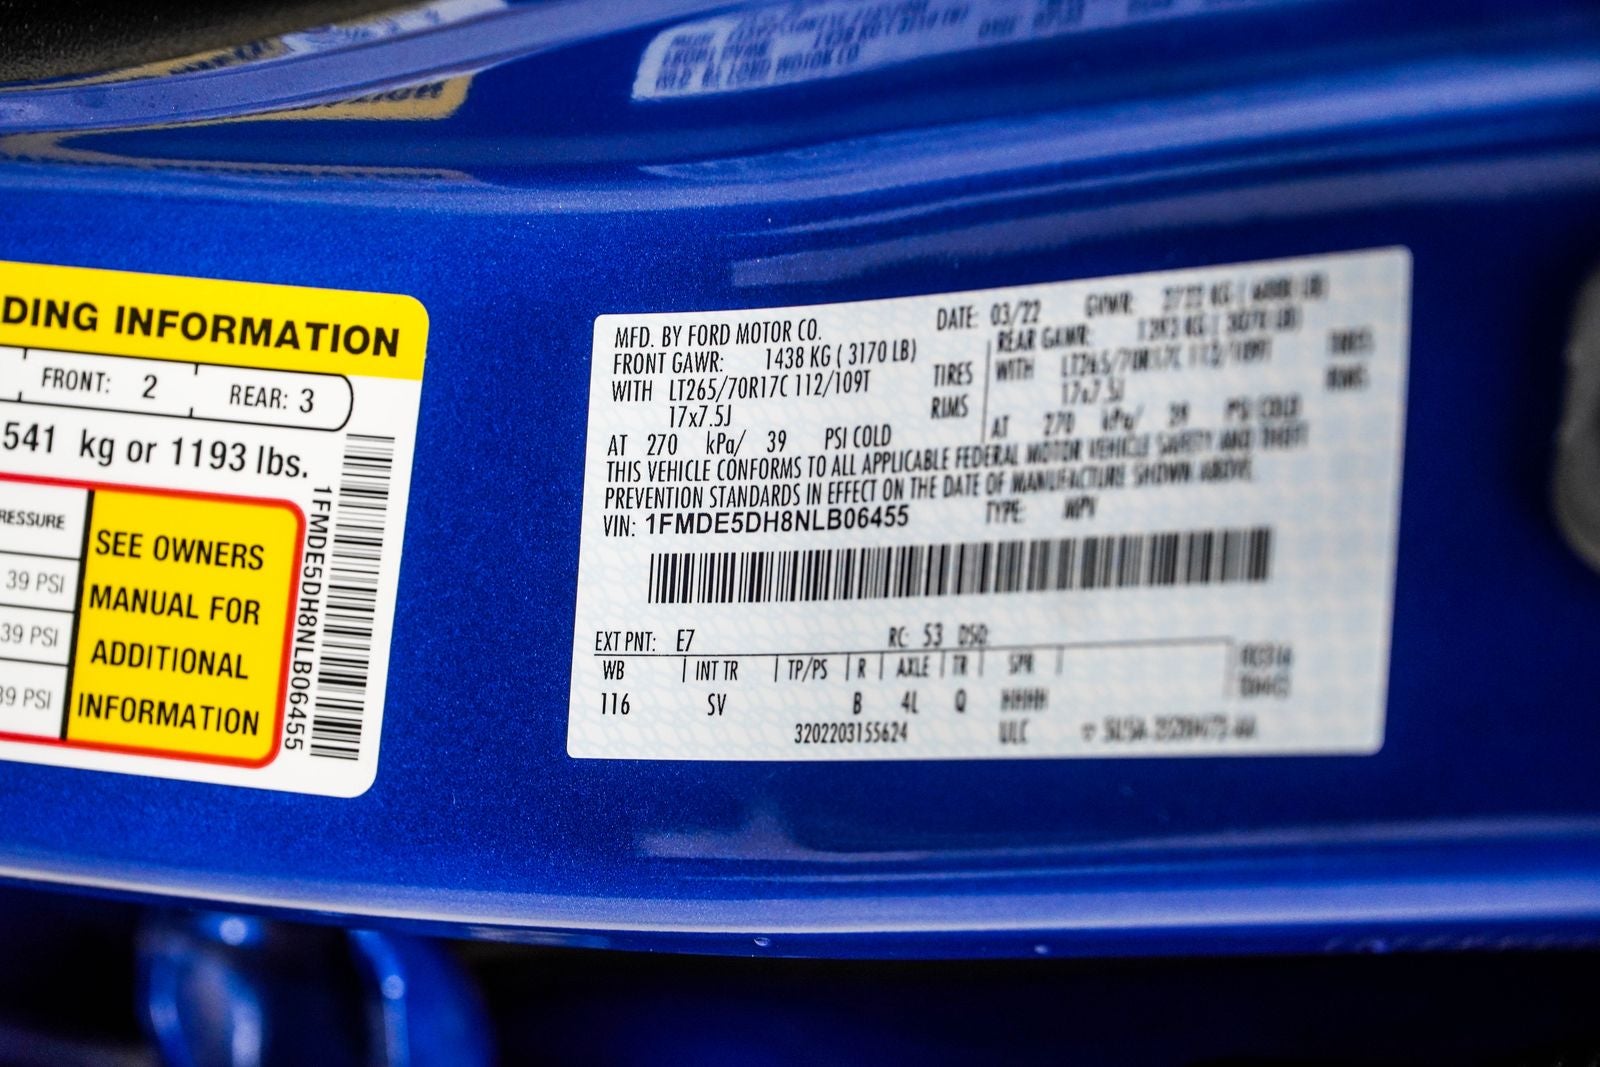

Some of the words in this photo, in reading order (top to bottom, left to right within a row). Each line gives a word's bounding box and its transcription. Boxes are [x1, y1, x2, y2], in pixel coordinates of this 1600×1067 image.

[0, 296, 98, 331] DING
[114, 306, 399, 358] INFORMATION
[937, 305, 979, 331] DATE:
[990, 298, 1041, 327] 03/22
[614, 326, 654, 348] MFD.
[662, 325, 682, 346] BY
[688, 323, 730, 346] FORD
[736, 320, 791, 345] MOTOR
[798, 319, 822, 342] CO.
[613, 352, 665, 374] FRONT
[672, 350, 724, 374] GAWR:
[766, 346, 804, 370] 1438
[810, 344, 831, 368] KG
[848, 341, 887, 366] 3170
[892, 339, 917, 363] LB)
[42, 367, 111, 393] FRONT:
[142, 375, 158, 399] 2
[612, 380, 652, 402] WITH
[669, 375, 789, 401] LT265/70R17C
[795, 369, 870, 397] 112/109T
[933, 361, 973, 387] TIRES
[229, 384, 287, 410] REAR:
[299, 389, 314, 413] 3
[931, 395, 968, 420] RIMS
[669, 405, 732, 428] 17x7.5J
[991, 414, 1010, 438] AT
[3, 422, 54, 453] 541
[80, 429, 114, 467] kg
[127, 440, 157, 463] or
[171, 438, 246, 472] 1193
[257, 445, 308, 479] lbs.
[607, 434, 627, 456] AT
[647, 433, 678, 456] 270
[706, 429, 746, 456] kPa/
[767, 431, 786, 452] 39
[825, 427, 849, 450] PSI
[854, 424, 892, 448] COLD
[607, 460, 641, 482] THIS
[648, 458, 711, 482] VEHICLE
[717, 457, 801, 481] CONFORMS
[808, 455, 826, 478] TO
[831, 453, 859, 477] ALL
[862, 449, 948, 476] APPLICABLE
[955, 439, 1018, 468] FEDERAL
[1026, 437, 1081, 464] MOTOR
[605, 486, 703, 510] PREVENTION
[709, 483, 800, 508] STANDARDS
[806, 482, 822, 507] IN
[828, 480, 877, 505] EFFECT
[882, 478, 903, 503] ON
[910, 475, 936, 501] THE
[944, 473, 980, 498] DATE
[986, 471, 1006, 496] OF
[603, 514, 636, 538] VIN:
[646, 504, 909, 536] 1FMDE5DH8NLB06455
[96, 529, 143, 558] SEE
[153, 534, 264, 571] OWNERS
[6, 569, 29, 590] 39
[36, 572, 65, 594] PSI
[89, 584, 199, 620] MANUAL
[210, 596, 261, 625] FOR
[285, 485, 332, 751] 1FMDE5DH8NLB06455
[1, 623, 23, 644] 39
[30, 627, 59, 647] PSI
[596, 631, 621, 651] EXT
[625, 631, 656, 651] PNT:
[676, 629, 695, 651] E7
[923, 623, 944, 647] 53
[90, 639, 248, 679] ADDITIONAL
[603, 659, 624, 680] WB
[696, 660, 719, 681] INT
[724, 659, 738, 681] TR
[788, 658, 828, 683] TP/PS
[858, 657, 866, 680] R
[897, 655, 930, 678] AXLE
[953, 654, 968, 676] TR
[23, 687, 52, 710] PSI
[601, 693, 630, 715] 116
[708, 693, 727, 716] SV
[853, 692, 862, 714] B
[901, 690, 918, 714] 4L
[954, 689, 966, 714] Q
[78, 692, 259, 736] INFORMATION
[794, 722, 907, 744] 3202203155624
